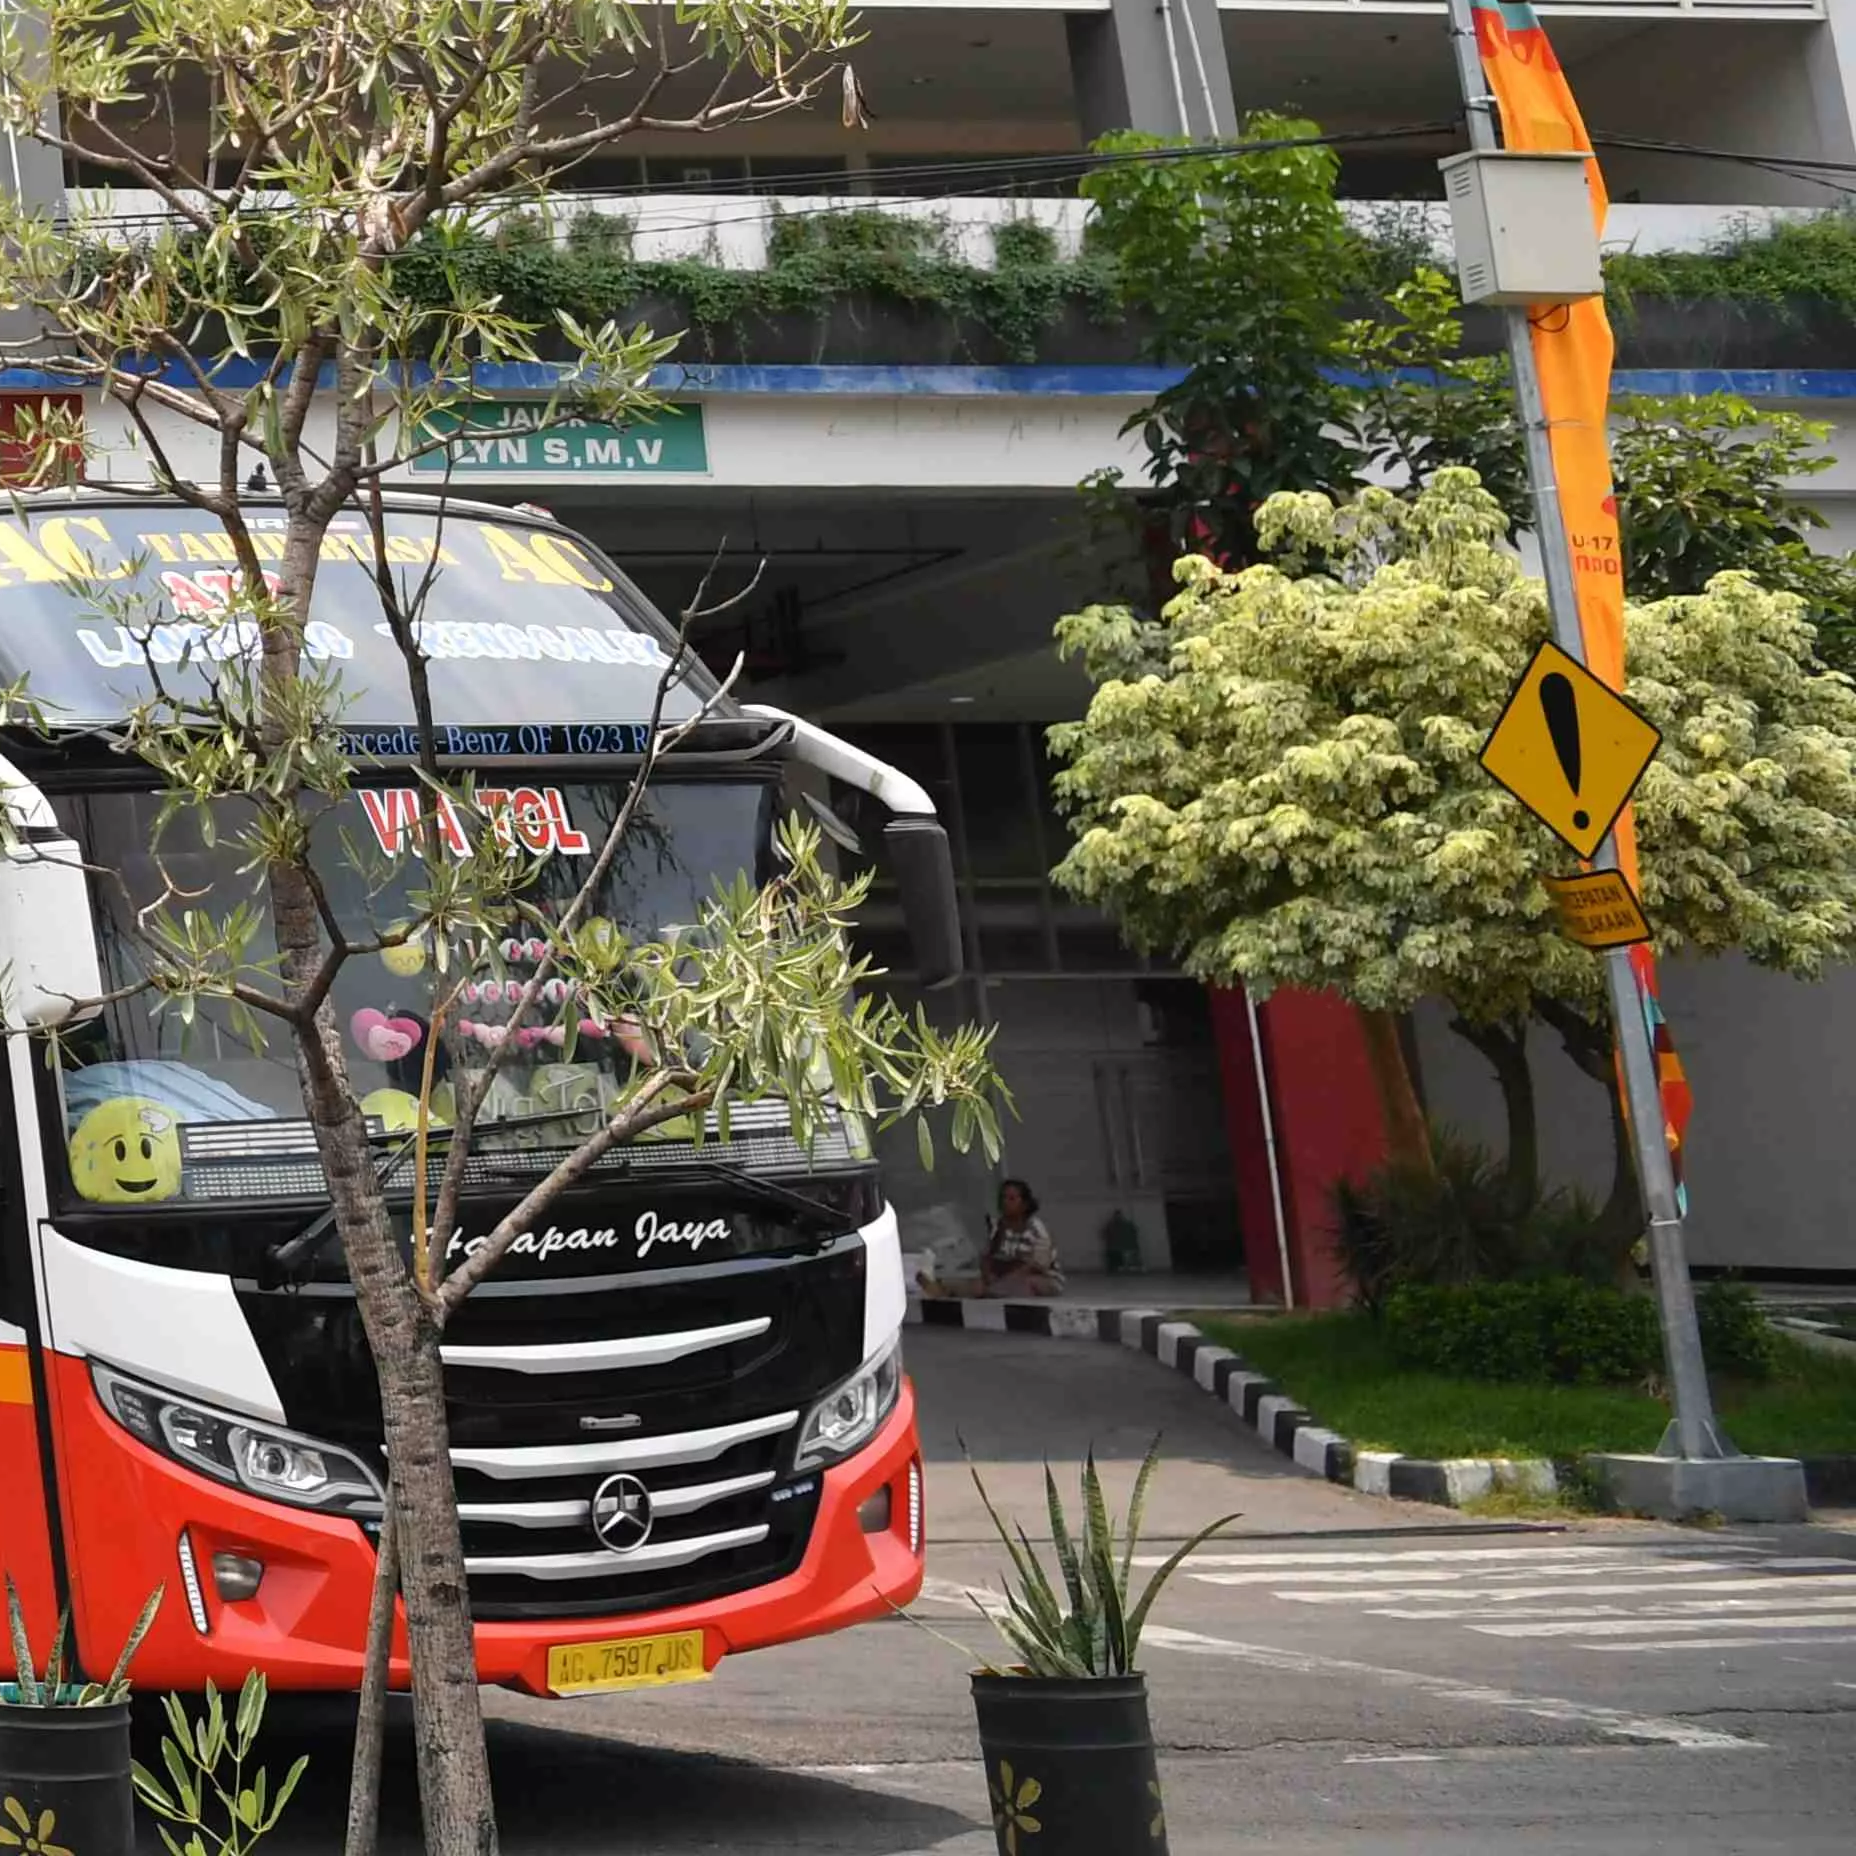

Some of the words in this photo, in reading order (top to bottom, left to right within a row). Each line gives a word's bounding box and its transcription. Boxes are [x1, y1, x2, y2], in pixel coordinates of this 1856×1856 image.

[453, 438, 528, 464] LYN
[479, 523, 614, 593] AC
[563, 725, 625, 754] 1623
[634, 1210, 732, 1259] Jaya
[600, 1643, 654, 1680] 7597
[664, 1638, 694, 1672] US
